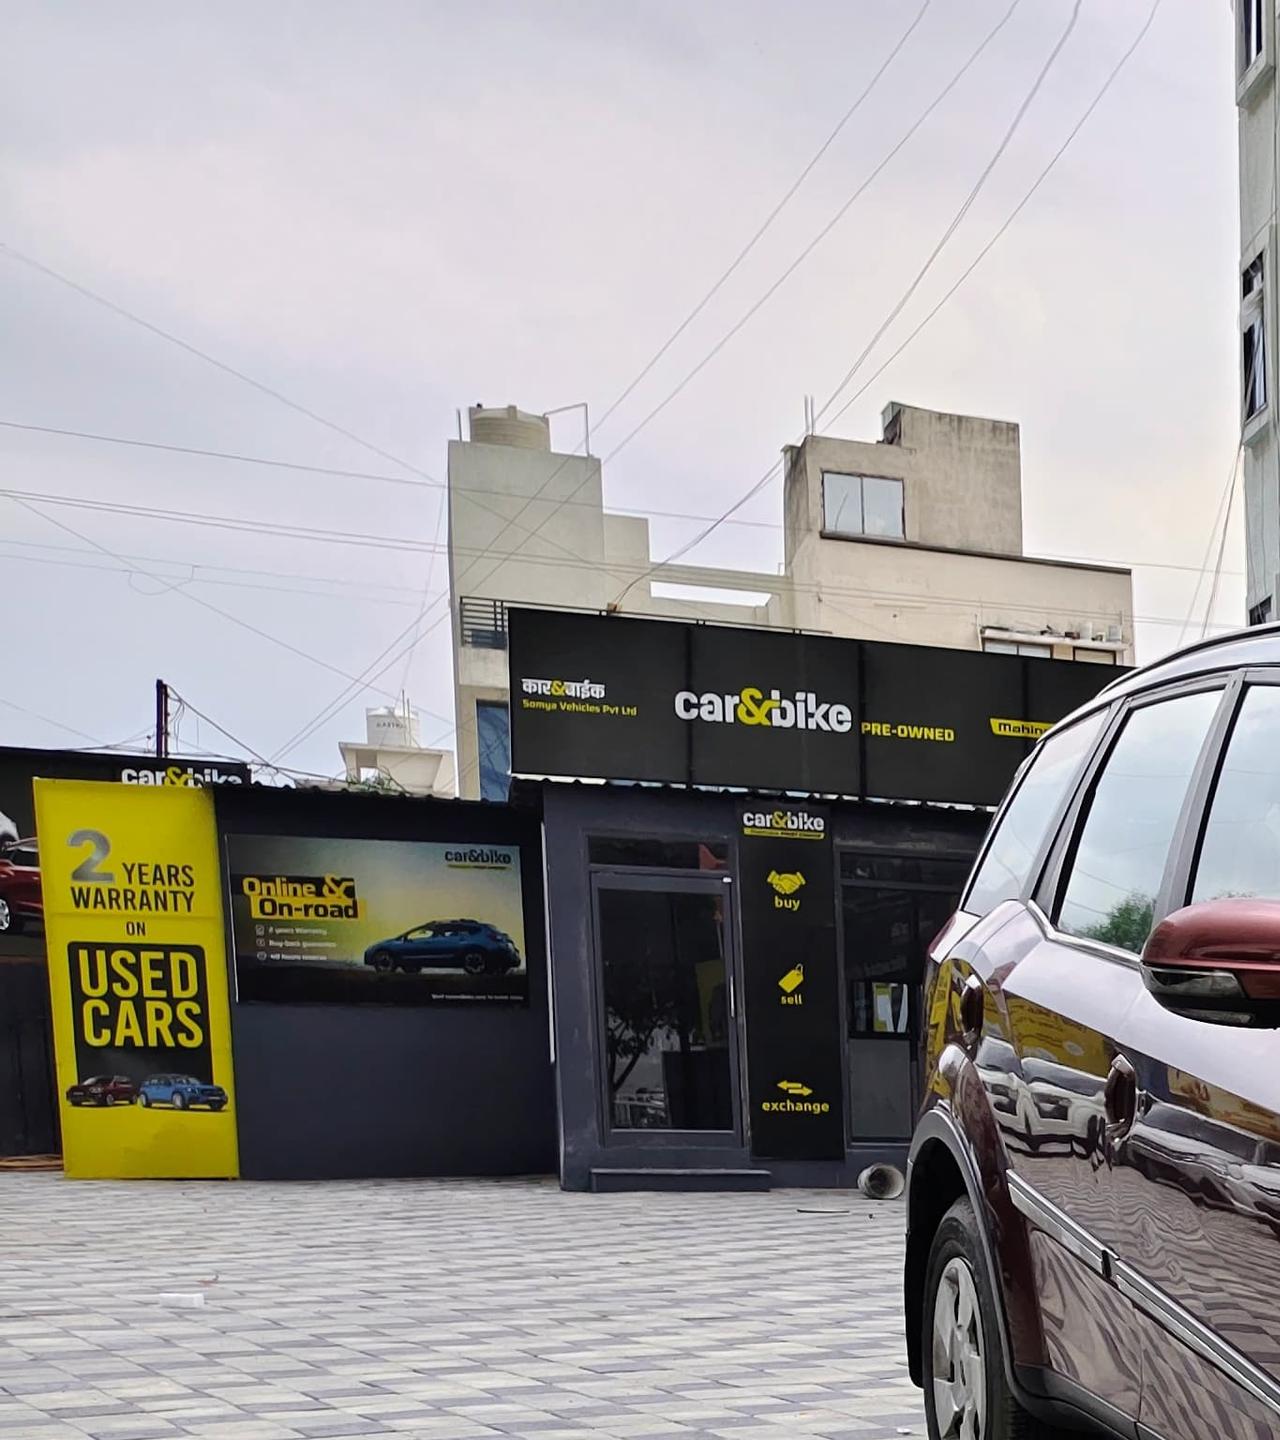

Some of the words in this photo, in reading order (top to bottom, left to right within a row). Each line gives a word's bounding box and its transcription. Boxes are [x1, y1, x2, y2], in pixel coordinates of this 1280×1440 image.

[559, 702, 600, 714] Vehicles
[603, 704, 619, 715] Pvt
[621, 706, 638, 717] Ltd
[674, 688, 852, 733] car&bike
[861, 722, 956, 742] PRE-OWNED
[998, 723, 1047, 735] Mahin
[743, 811, 825, 831] car&bike
[68, 829, 115, 882] 2
[122, 862, 195, 887] YEARS
[242, 876, 317, 897] Online
[322, 874, 355, 899] &
[71, 886, 195, 912] WARRANTY
[259, 898, 359, 918] On-road
[774, 895, 801, 911] buy
[126, 921, 146, 936] ON
[78, 949, 198, 998] USED
[781, 994, 802, 1005] sell
[83, 999, 203, 1047] CARS
[762, 1099, 830, 1114] exchange
